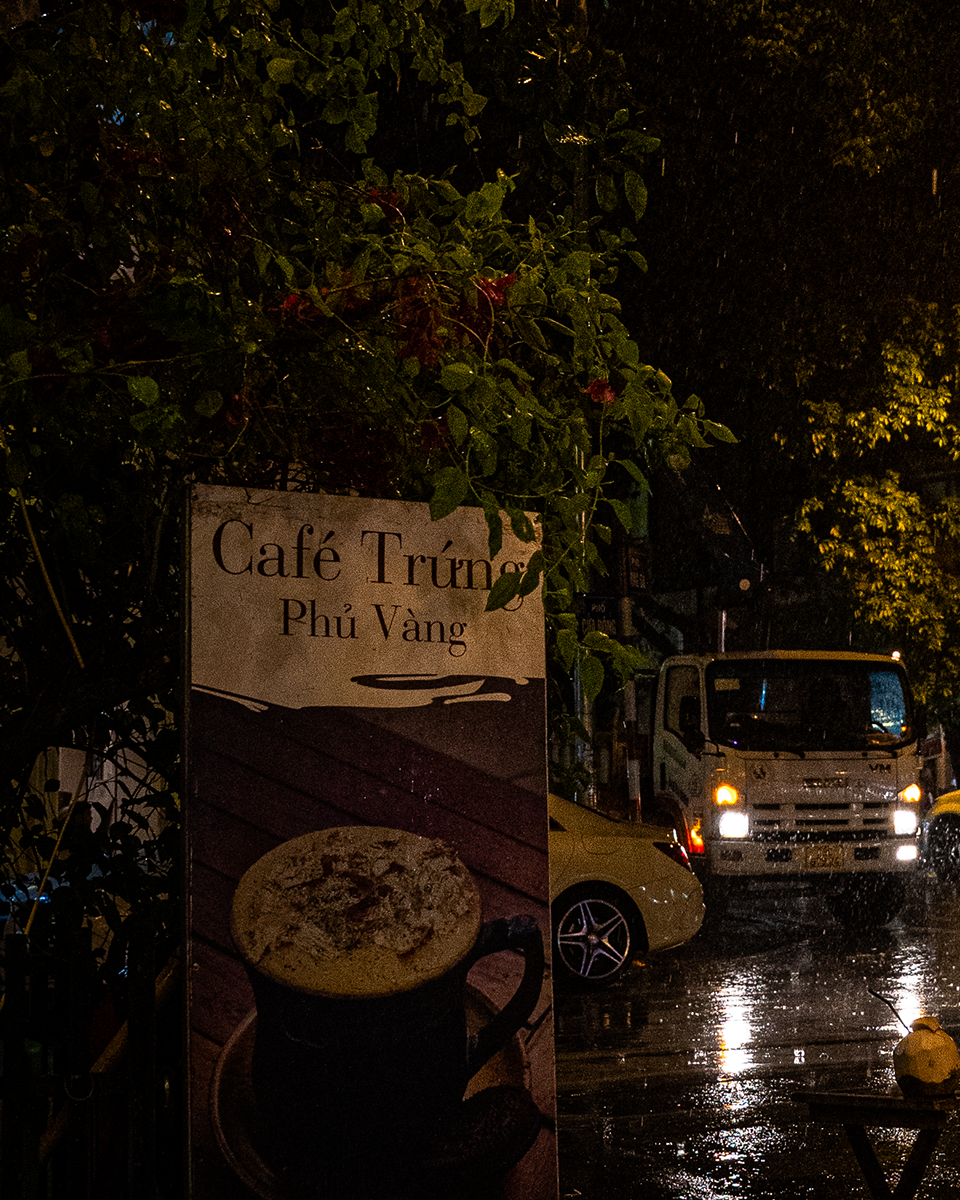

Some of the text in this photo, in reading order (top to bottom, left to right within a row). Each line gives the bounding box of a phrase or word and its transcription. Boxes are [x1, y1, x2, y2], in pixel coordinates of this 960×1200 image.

[213, 518, 342, 581] Café
[279, 598, 467, 658] Phủ Vàng
[869, 763, 891, 774] VM
